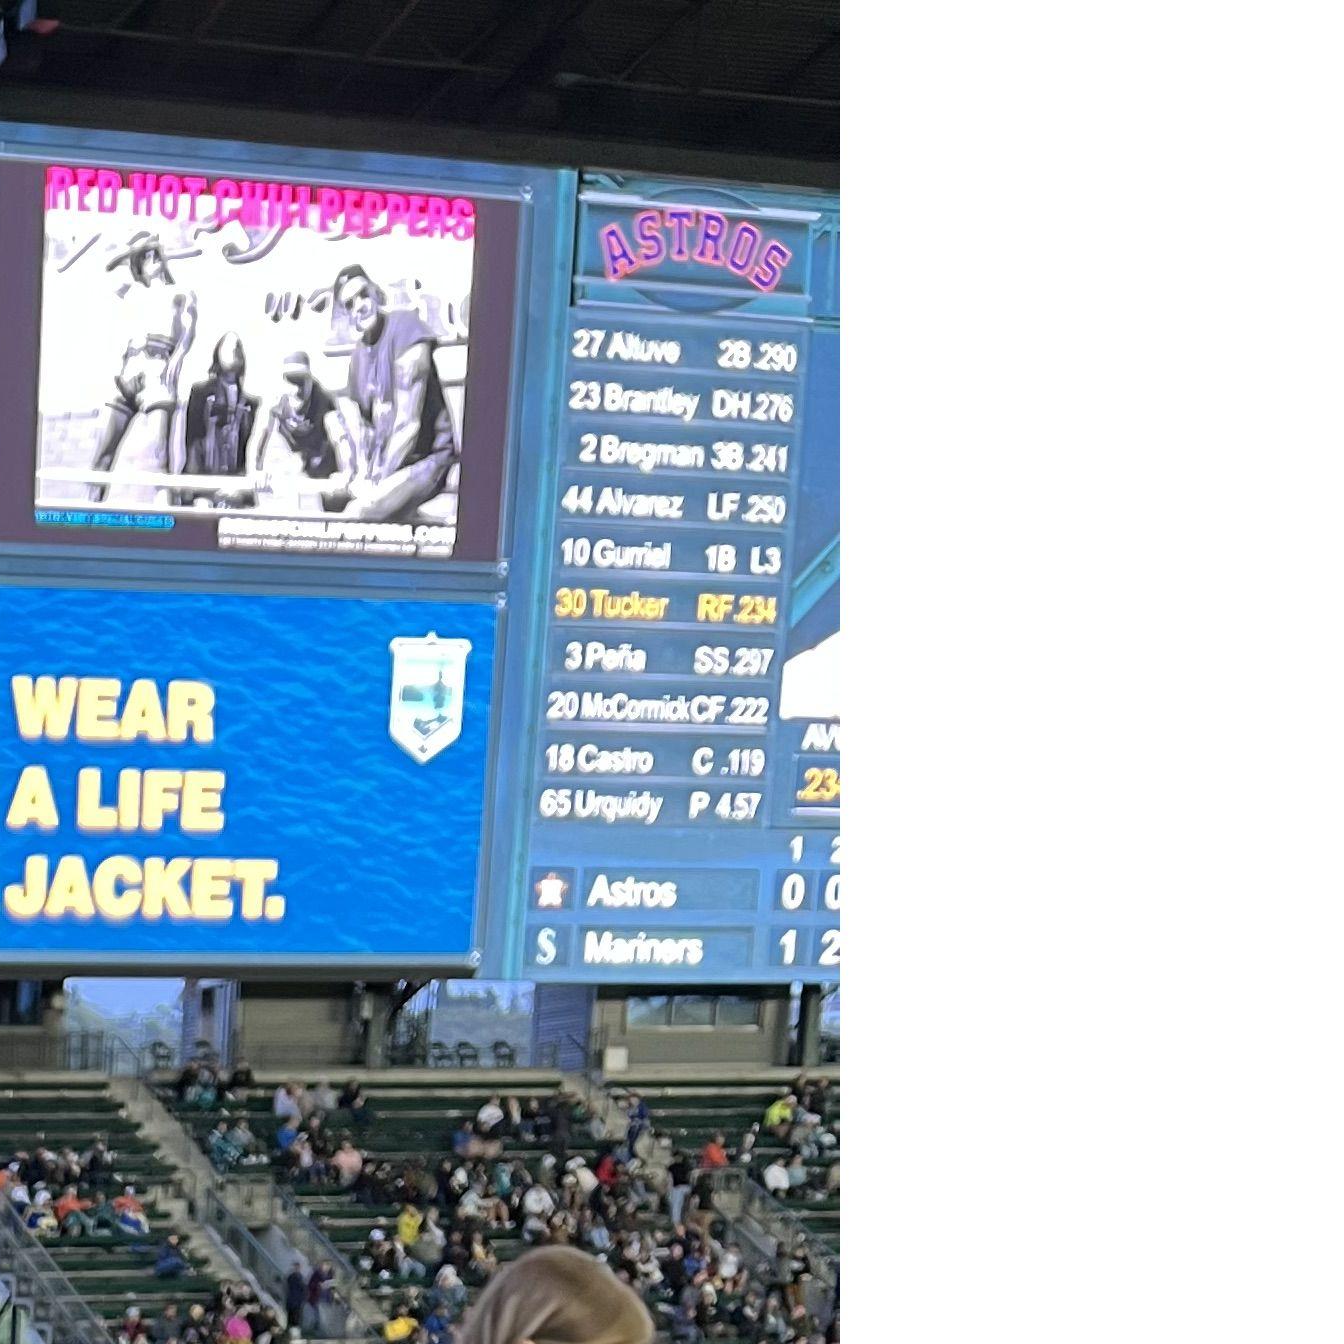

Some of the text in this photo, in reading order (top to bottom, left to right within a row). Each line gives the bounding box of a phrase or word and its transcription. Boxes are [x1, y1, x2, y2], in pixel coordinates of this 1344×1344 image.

[46, 166, 122, 213] RED
[129, 172, 207, 222] HOT
[316, 186, 477, 242] PEPPERS
[599, 208, 793, 293] ASTROS
[573, 329, 606, 358] 27
[606, 331, 681, 364] Altuve
[717, 339, 751, 369] 2B
[569, 381, 602, 410] 23
[604, 383, 700, 422] Brantley
[712, 389, 752, 419] DH
[579, 434, 789, 473] 2 Bregman 3B .241
[562, 485, 593, 514] 44
[595, 486, 685, 520] Alvarez
[707, 492, 741, 521] LF
[561, 537, 591, 566] 10
[705, 544, 737, 573] 1B
[750, 546, 782, 574] L3
[555, 587, 587, 617] 30
[590, 589, 670, 620] Tucker
[697, 593, 735, 622] RF
[564, 641, 583, 671] 3
[694, 645, 730, 676] SS
[10, 673, 216, 743] WEAR
[546, 690, 579, 721] 20
[689, 695, 728, 723] CF
[725, 697, 770, 725] .222
[545, 743, 766, 777] 18 Castro C .119
[5, 765, 227, 831] A LIFE
[797, 767, 840, 801] .23
[539, 789, 762, 825] 65 Urquidy P 4.57
[790, 835, 804, 864] 1
[3, 852, 287, 920] JACKET.
[585, 874, 678, 909] Astros
[781, 873, 806, 910] 0
[582, 930, 705, 966] Mariners
[778, 929, 797, 966] 1
